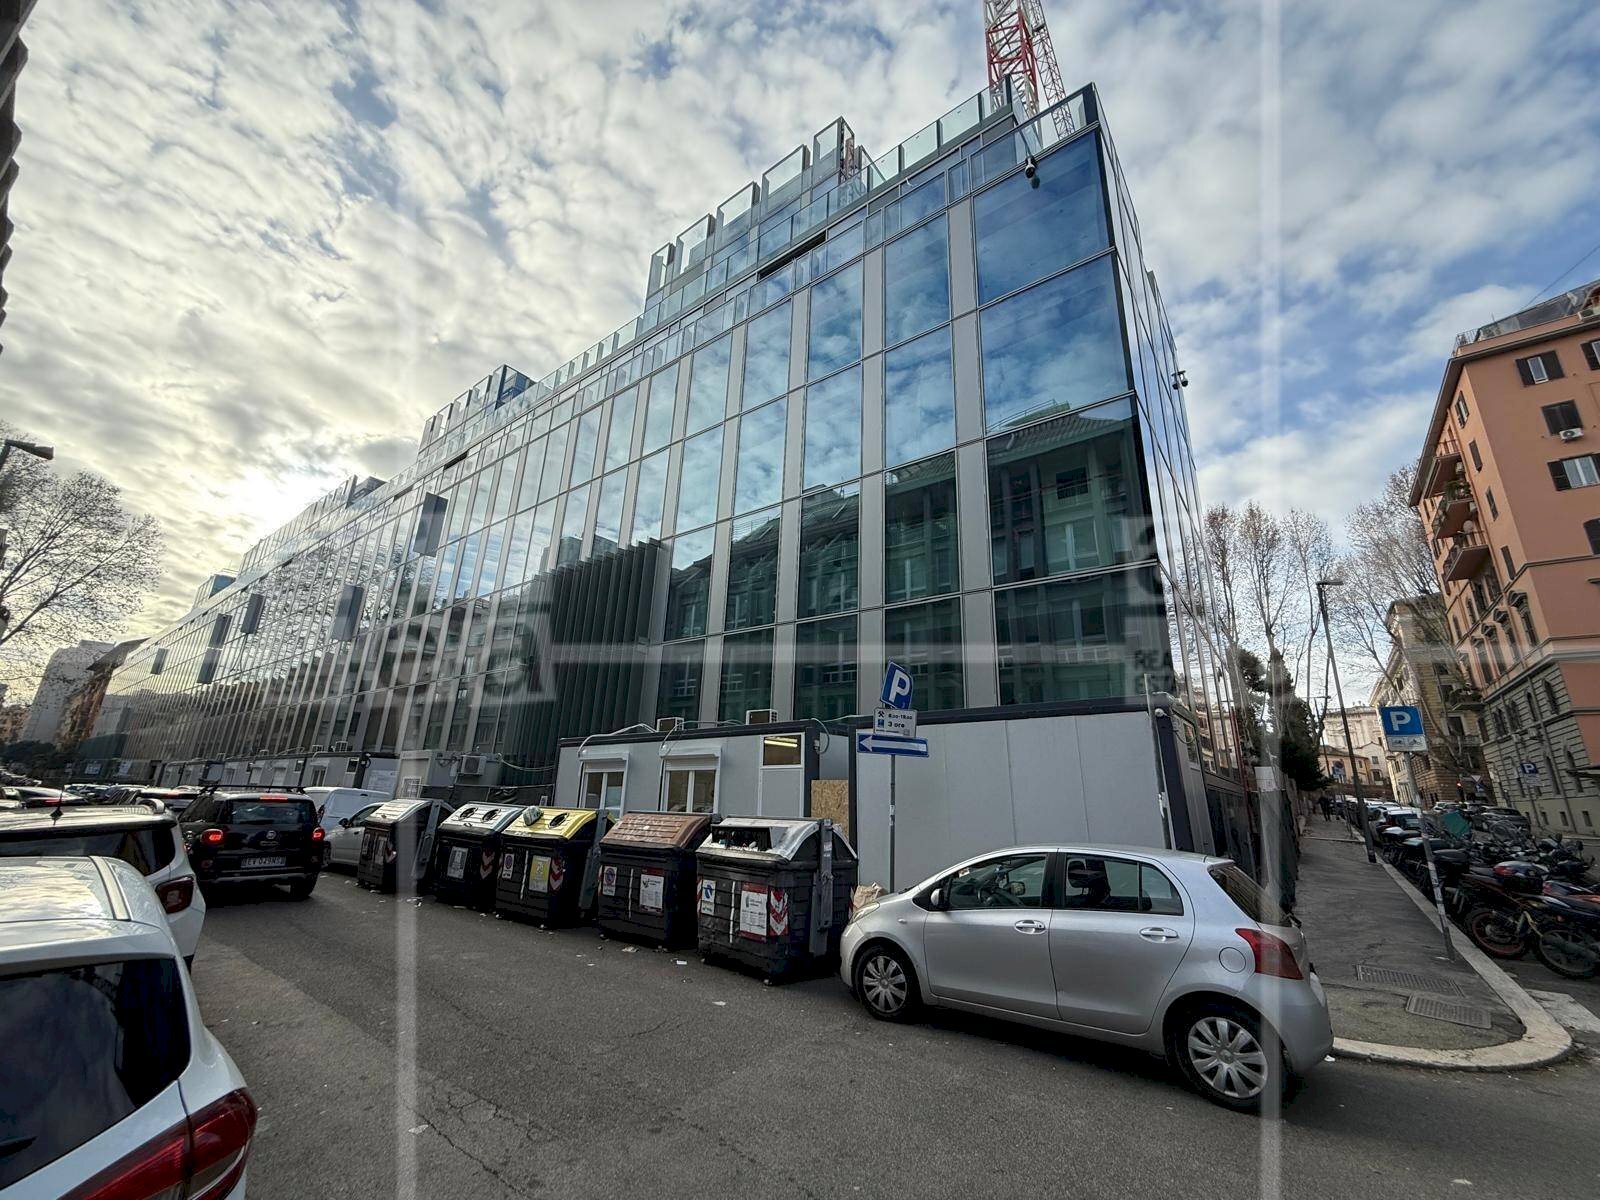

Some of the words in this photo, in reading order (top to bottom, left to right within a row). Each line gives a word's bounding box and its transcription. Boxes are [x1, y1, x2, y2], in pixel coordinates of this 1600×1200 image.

[889, 669, 911, 703] P
[1390, 711, 1411, 731] P
[1523, 763, 1535, 773] P
